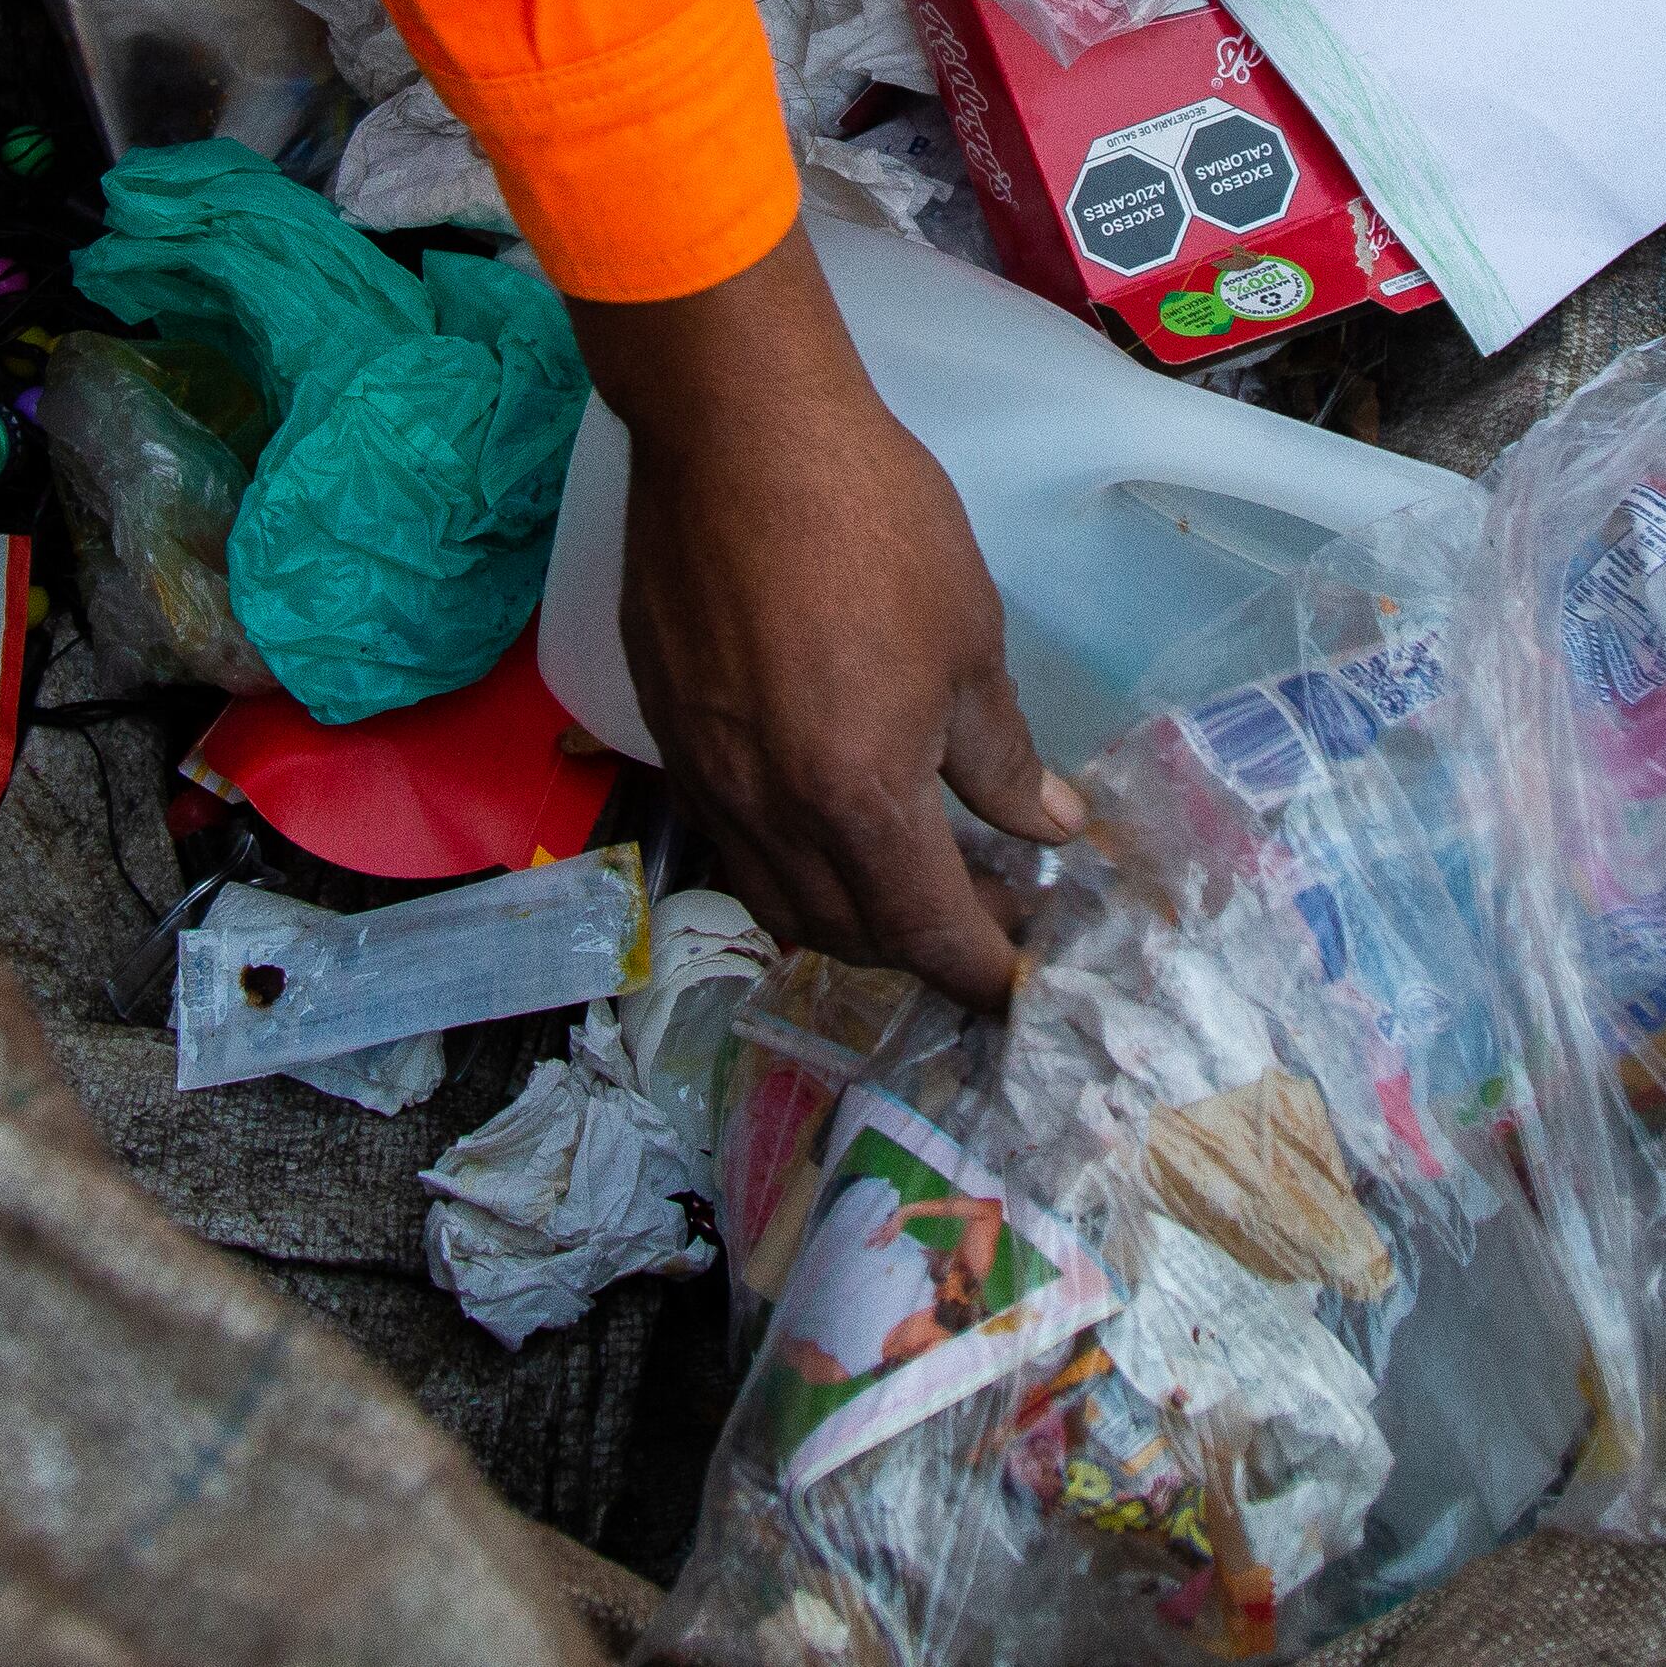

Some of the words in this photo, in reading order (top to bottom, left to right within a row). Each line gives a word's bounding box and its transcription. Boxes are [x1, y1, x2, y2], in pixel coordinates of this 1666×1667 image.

[919, 1, 1014, 205] Kellogg's
[1154, 103, 1207, 131] SECRETARÍA
[1105, 129, 1137, 148] SALUD
[1138, 124, 1151, 136] DE
[1193, 141, 1273, 182] CALORÍAS
[1208, 161, 1273, 196] EXCESO
[1081, 179, 1169, 224] AZÚCARES
[1099, 201, 1165, 237] EXCESO
[1222, 262, 1277, 287] RECICLADOS
[1227, 266, 1287, 298] 100%
[1237, 278, 1290, 302] MATERIALES
